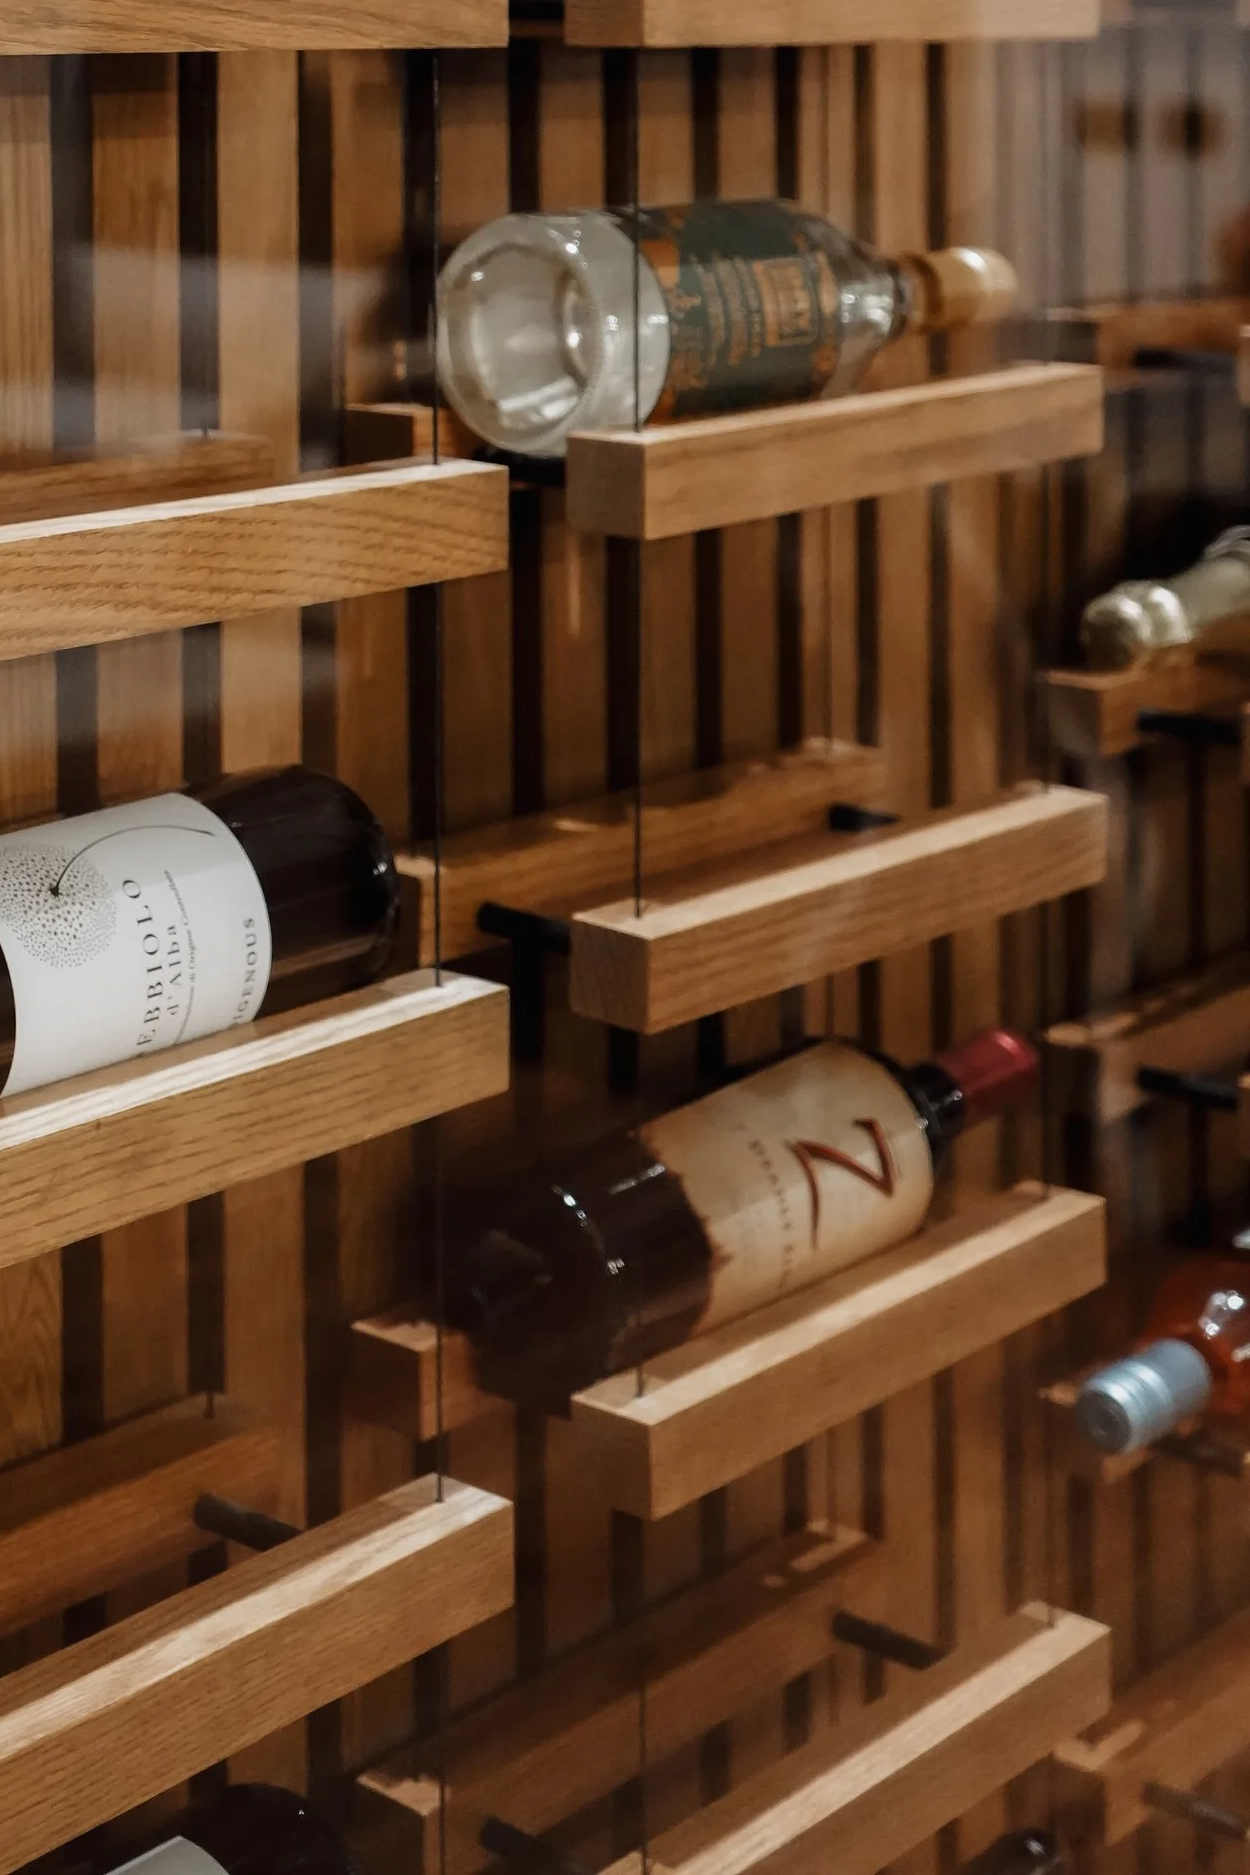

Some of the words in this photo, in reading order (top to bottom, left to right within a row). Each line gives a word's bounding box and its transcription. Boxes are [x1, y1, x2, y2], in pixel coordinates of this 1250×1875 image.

[122, 879, 163, 1051] EBBIOLO
[166, 924, 182, 1016] d'Alba
[230, 917, 258, 1027] IGENOUS
